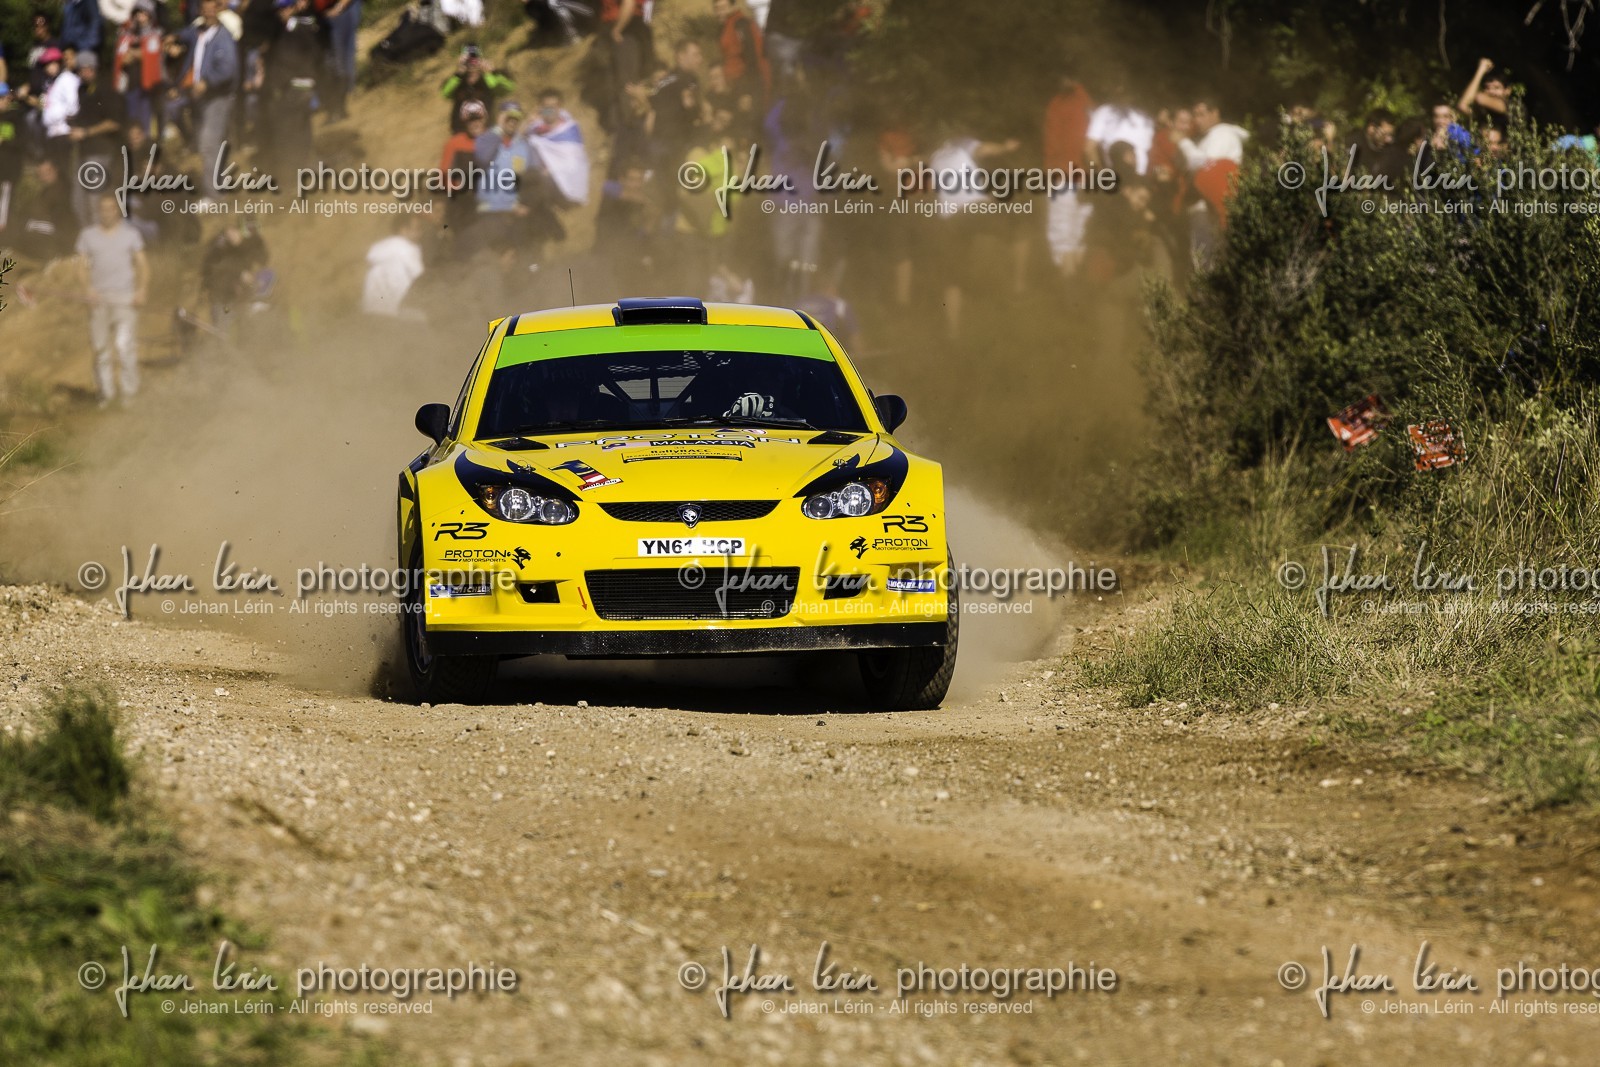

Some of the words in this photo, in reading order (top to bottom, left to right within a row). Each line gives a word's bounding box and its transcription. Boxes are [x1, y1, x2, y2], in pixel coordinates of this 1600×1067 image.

[556, 433, 801, 449] PROTON
[651, 440, 755, 448] MALAYSIA
[881, 515, 929, 533] R3
[434, 522, 490, 541] R3
[642, 540, 692, 554] YN61
[874, 538, 928, 547] PROTON
[444, 549, 507, 558] PROTON
